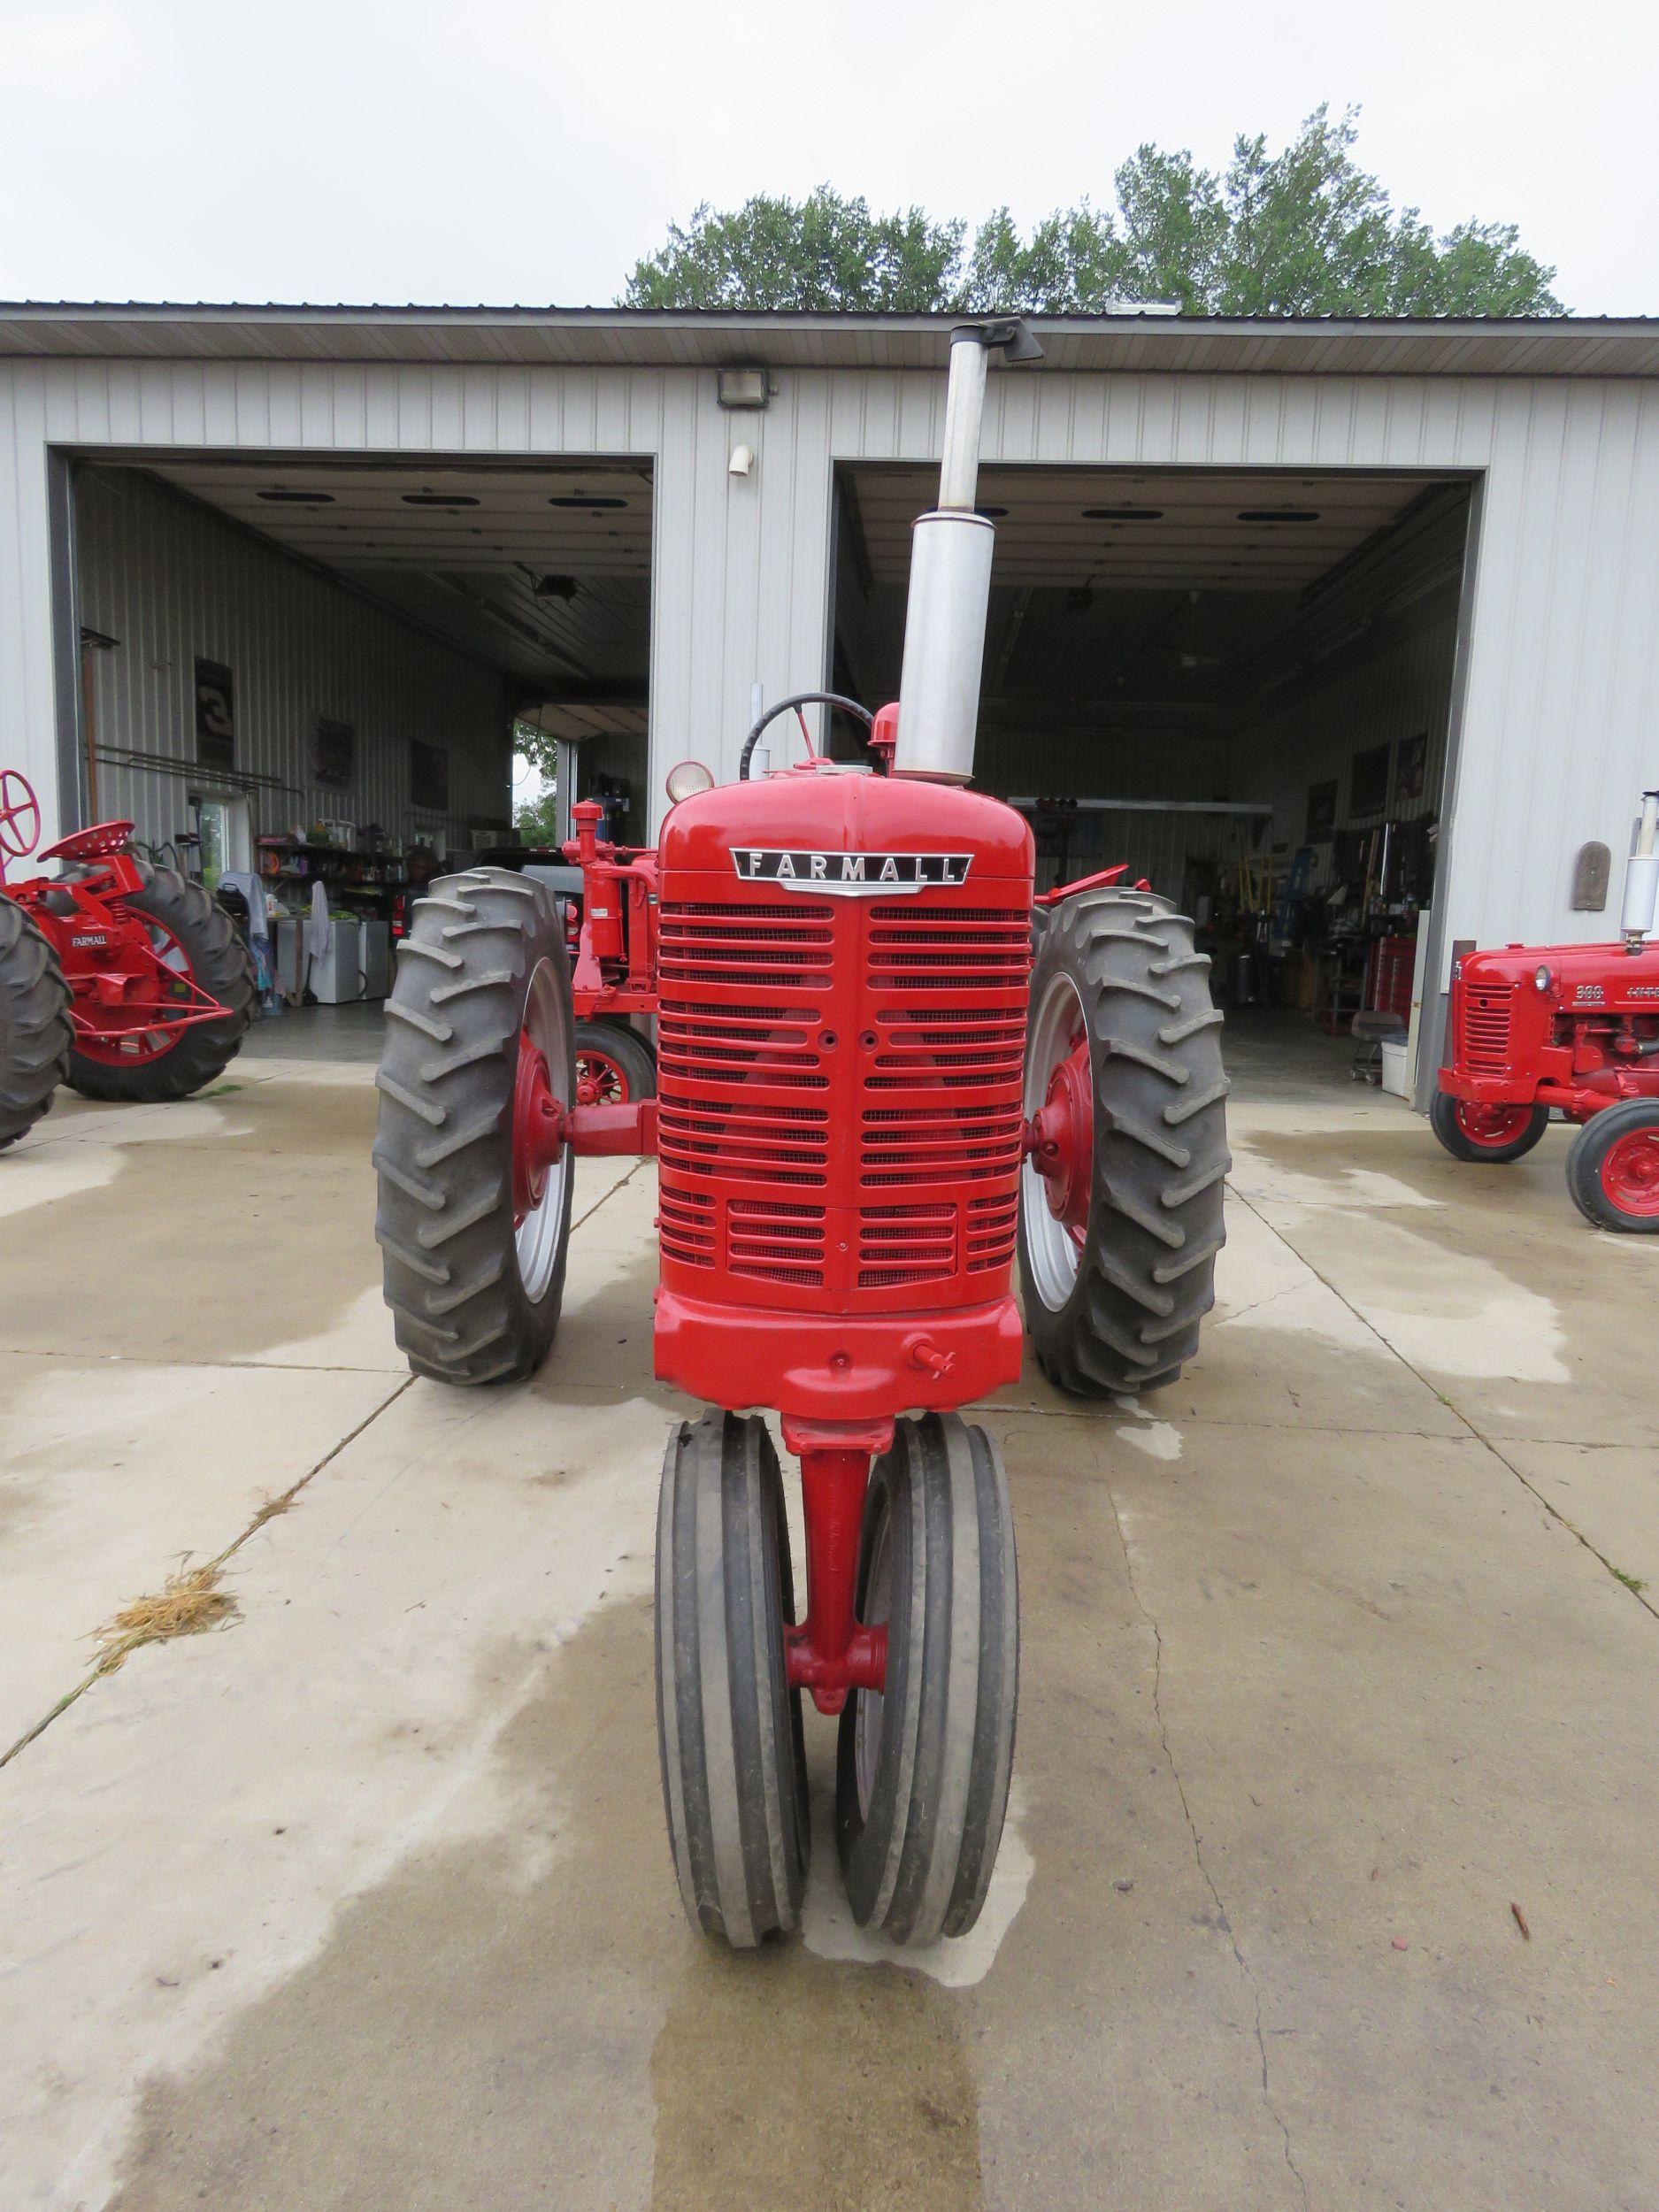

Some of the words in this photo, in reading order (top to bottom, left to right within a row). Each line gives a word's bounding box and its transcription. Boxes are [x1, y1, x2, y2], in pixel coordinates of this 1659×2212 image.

[197, 686, 233, 737] 3
[749, 853, 955, 881] FARMALL
[73, 935, 107, 947] FARMALL
